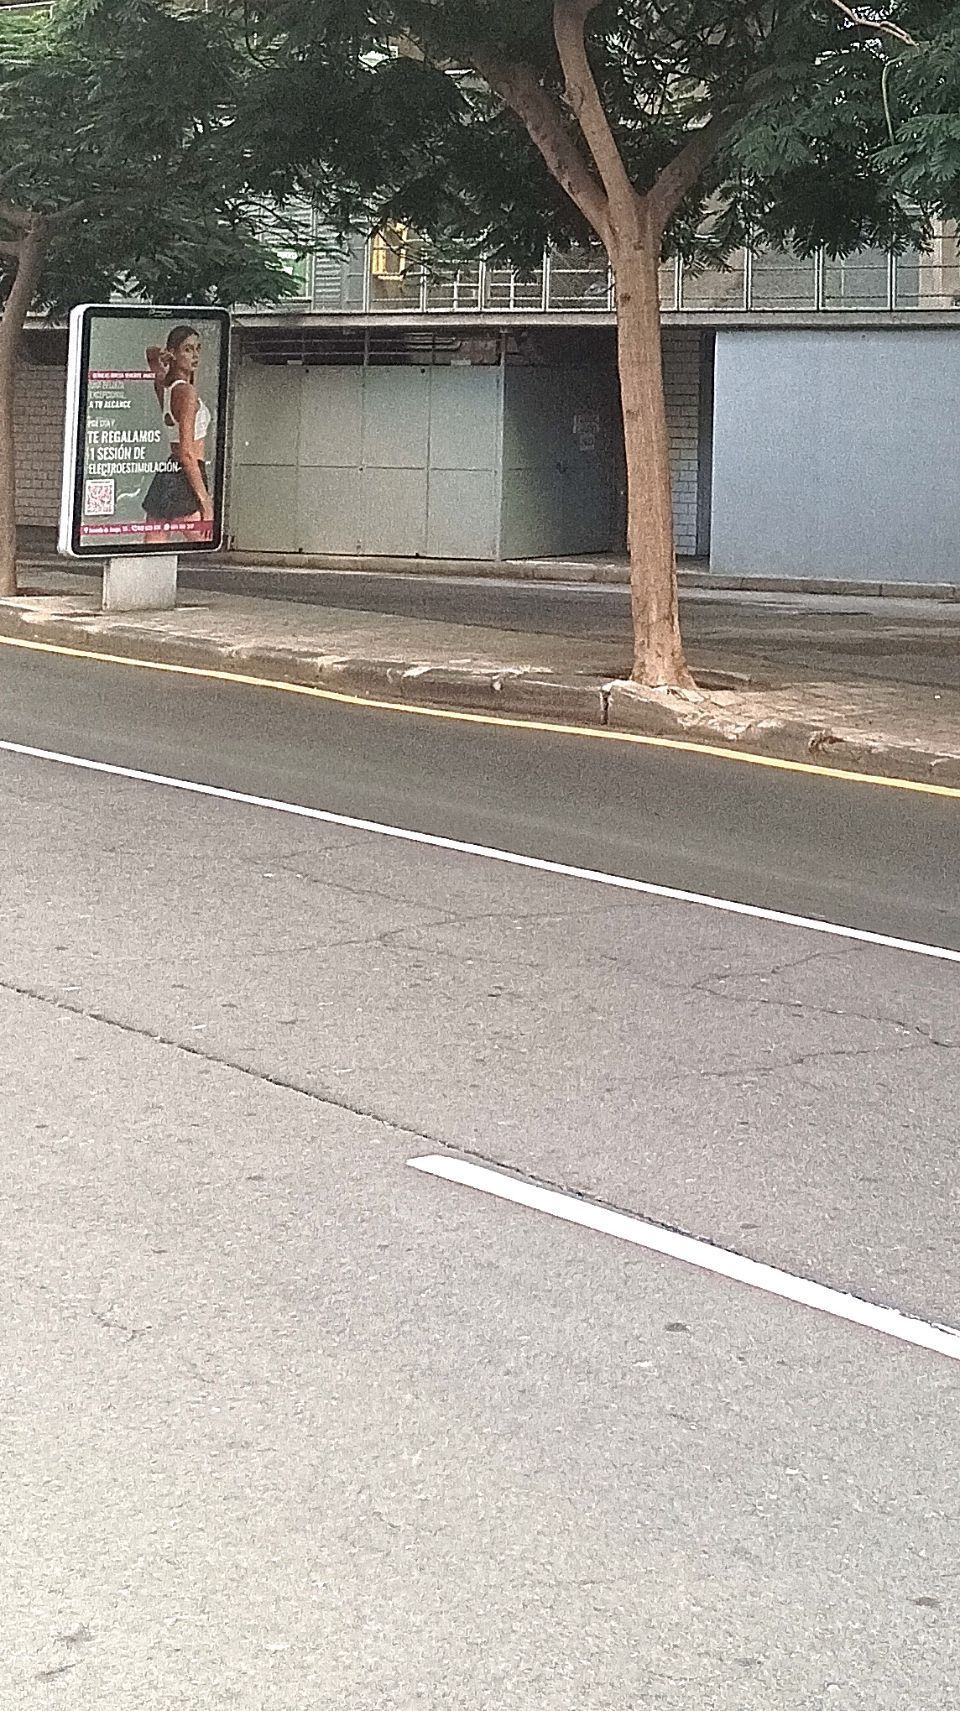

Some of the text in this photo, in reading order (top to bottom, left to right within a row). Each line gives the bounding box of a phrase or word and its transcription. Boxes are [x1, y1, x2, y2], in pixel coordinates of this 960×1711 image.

[87, 430, 161, 443] TE REGALAMOS
[90, 444, 146, 460] 1 SESIÓN DE
[89, 459, 181, 476] ELECTROESTIMULACIÓN
